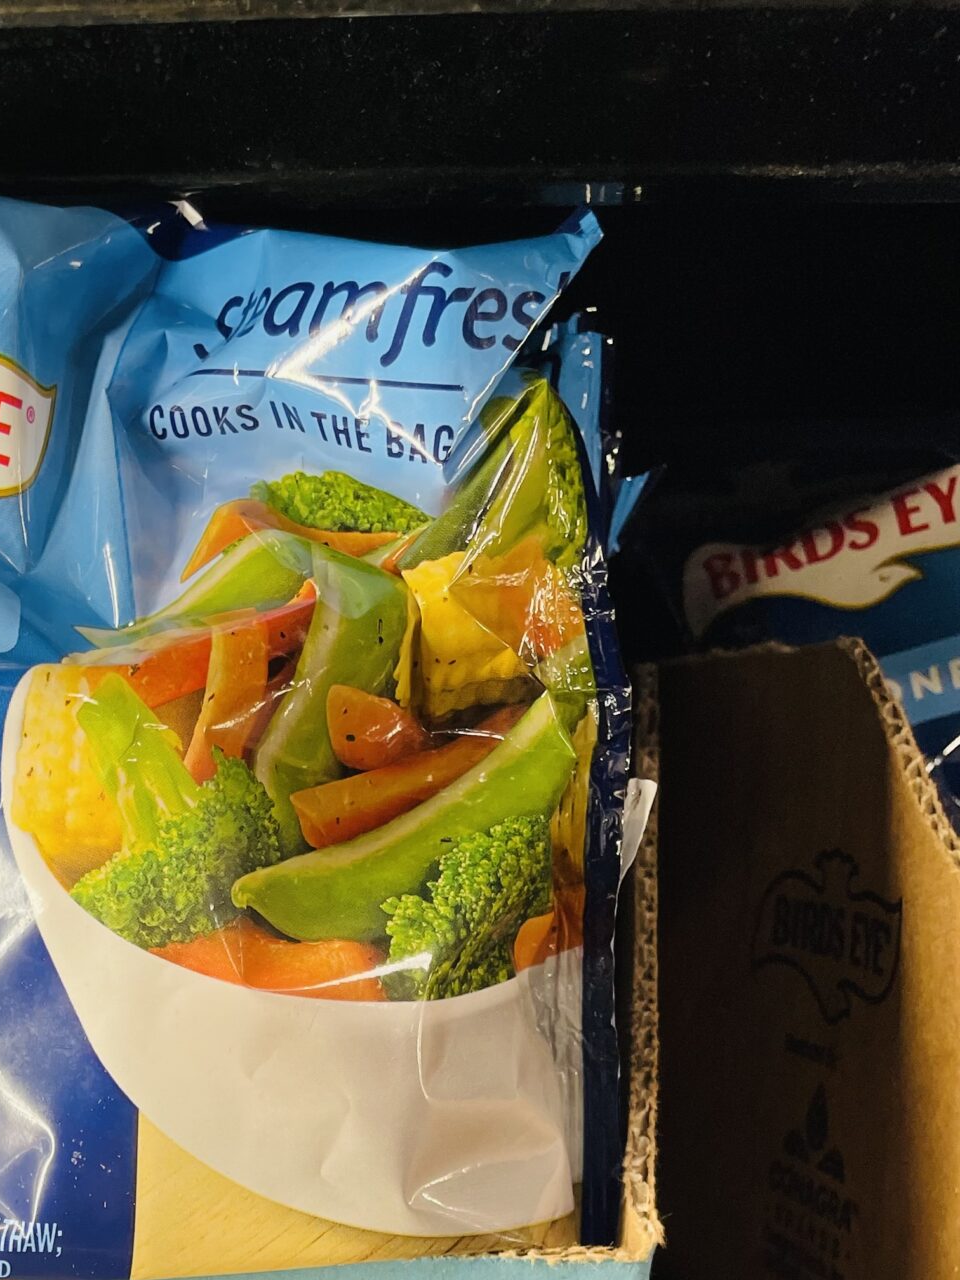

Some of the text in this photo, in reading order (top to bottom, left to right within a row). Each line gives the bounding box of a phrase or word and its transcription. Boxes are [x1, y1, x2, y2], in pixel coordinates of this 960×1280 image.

[149, 400, 455, 465] COOKS IN THE BAG
[702, 506, 881, 600] BIRDS
